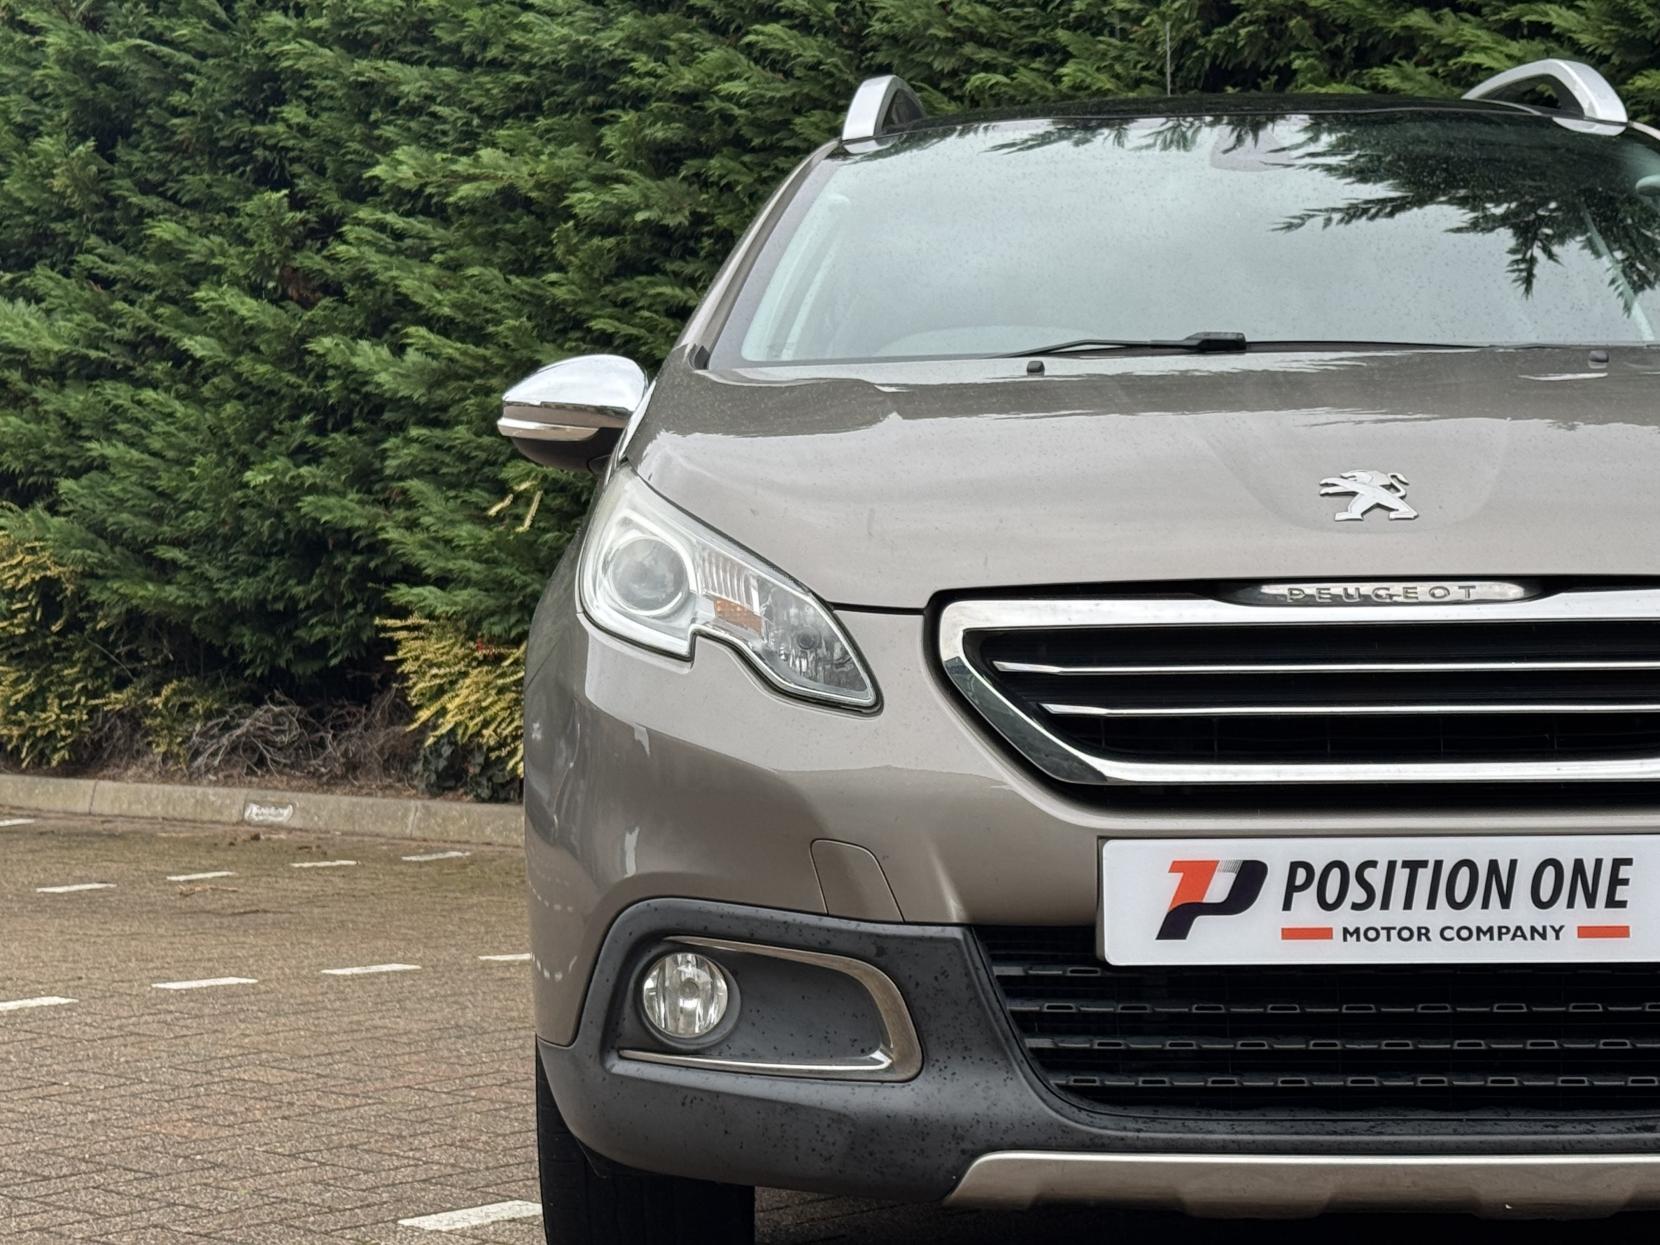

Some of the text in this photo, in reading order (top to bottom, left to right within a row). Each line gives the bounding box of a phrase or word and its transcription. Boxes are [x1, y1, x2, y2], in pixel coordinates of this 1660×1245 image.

[1286, 586, 1477, 603] PEUGEOT
[1281, 857, 1634, 912] POSITION ONE
[1342, 924, 1565, 943] MOTOR COMPANY
